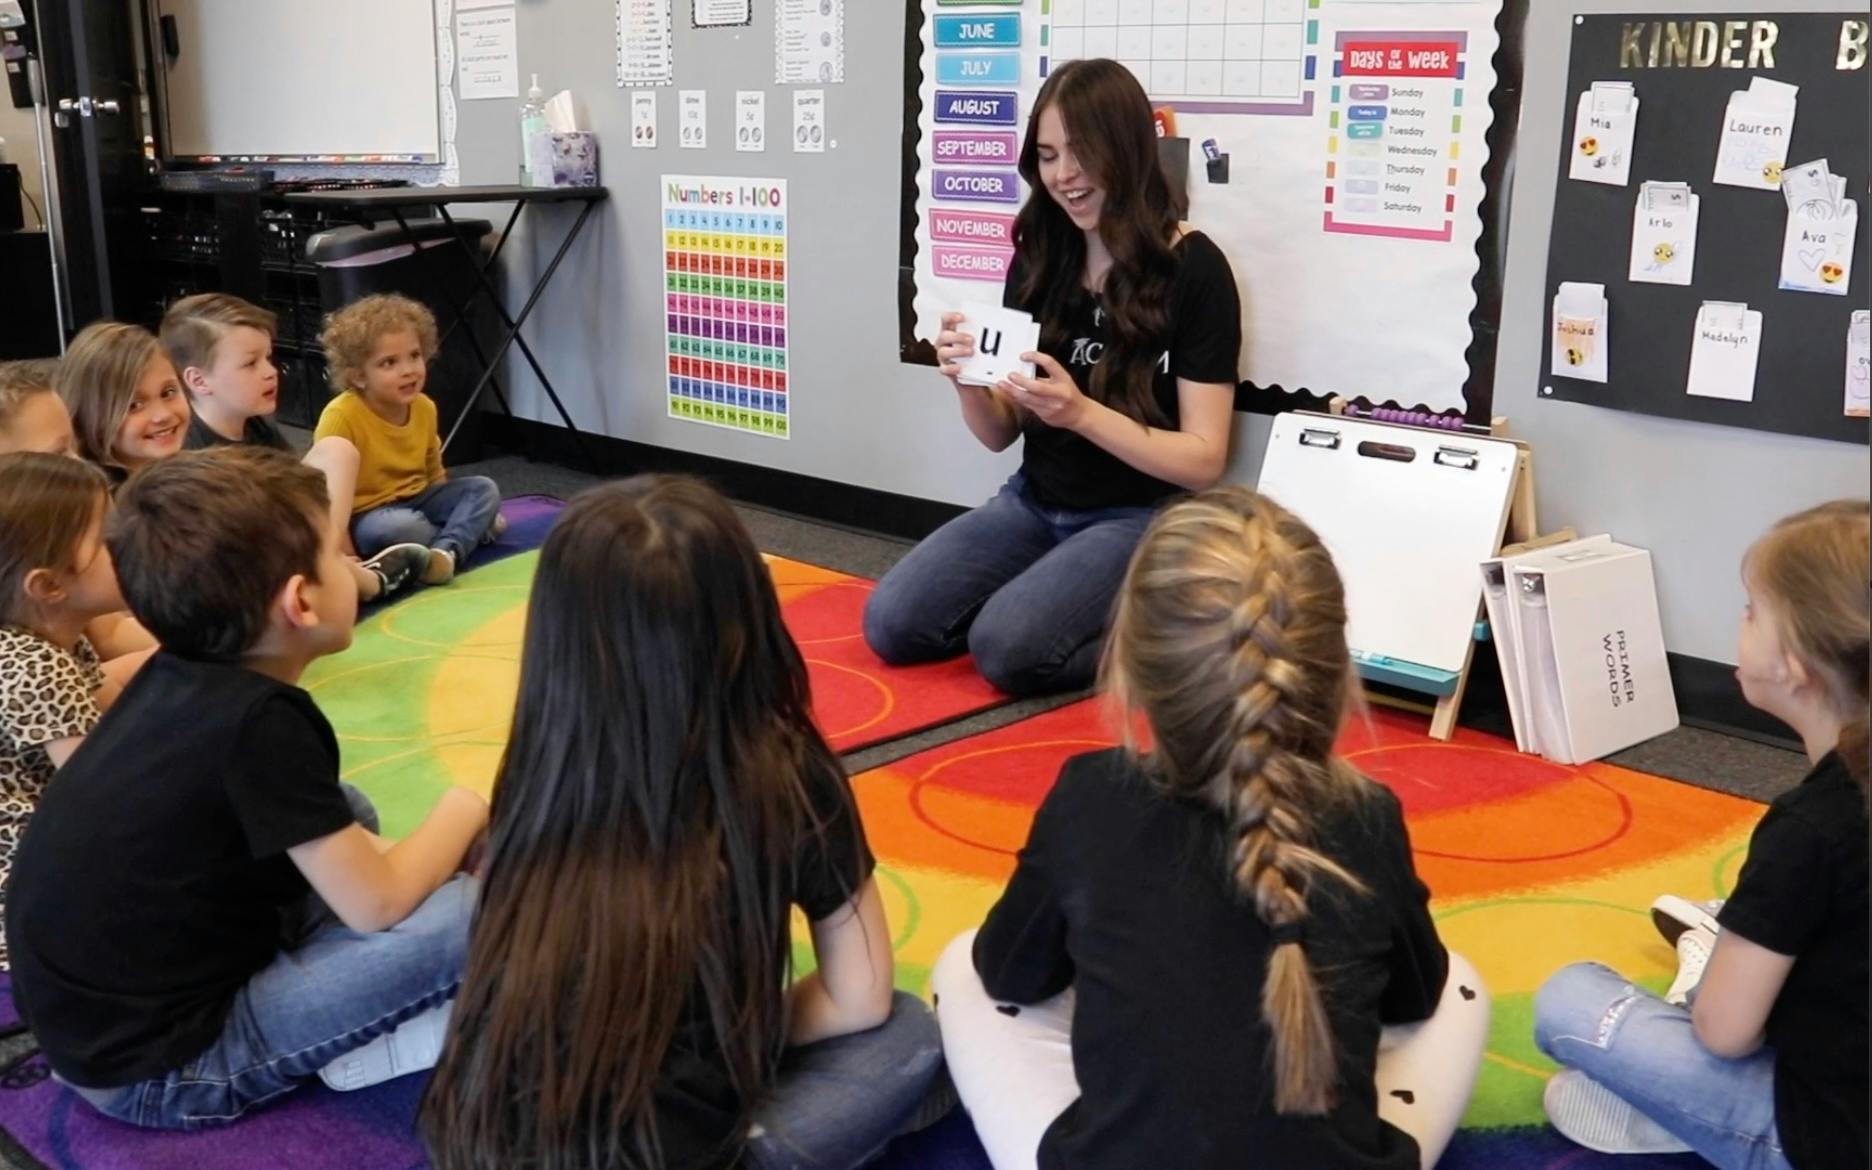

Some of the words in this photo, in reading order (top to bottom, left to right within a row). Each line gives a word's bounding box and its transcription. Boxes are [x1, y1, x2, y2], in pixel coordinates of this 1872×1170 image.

[958, 23, 995, 39] JUNE
[1618, 20, 1780, 69] KINDER
[960, 60, 992, 76] JULY
[1392, 88, 1424, 98] Sunday
[797, 97, 821, 106] quarter
[948, 100, 1000, 116] AUGUST
[1390, 107, 1425, 118] Monday
[1388, 126, 1424, 137] Tuesday
[1590, 117, 1612, 130] Mia
[1730, 119, 1783, 136] Lauren
[937, 140, 1008, 157] SEPTEMBER
[1387, 145, 1438, 156] Wednesday
[1386, 164, 1425, 176] Thursday
[944, 176, 1004, 193] OCTOBER
[1384, 182, 1411, 194] Friday
[668, 184, 734, 205] Numbers
[740, 186, 780, 207] 1-100
[1384, 202, 1422, 213] Saturday
[936, 219, 1005, 238] NOVEMBER
[1802, 230, 1827, 244] Ava
[940, 254, 1005, 272] DECEMBER
[979, 326, 1002, 357] u
[1602, 634, 1622, 708] WORDS
[1616, 630, 1635, 703] PRIMER
